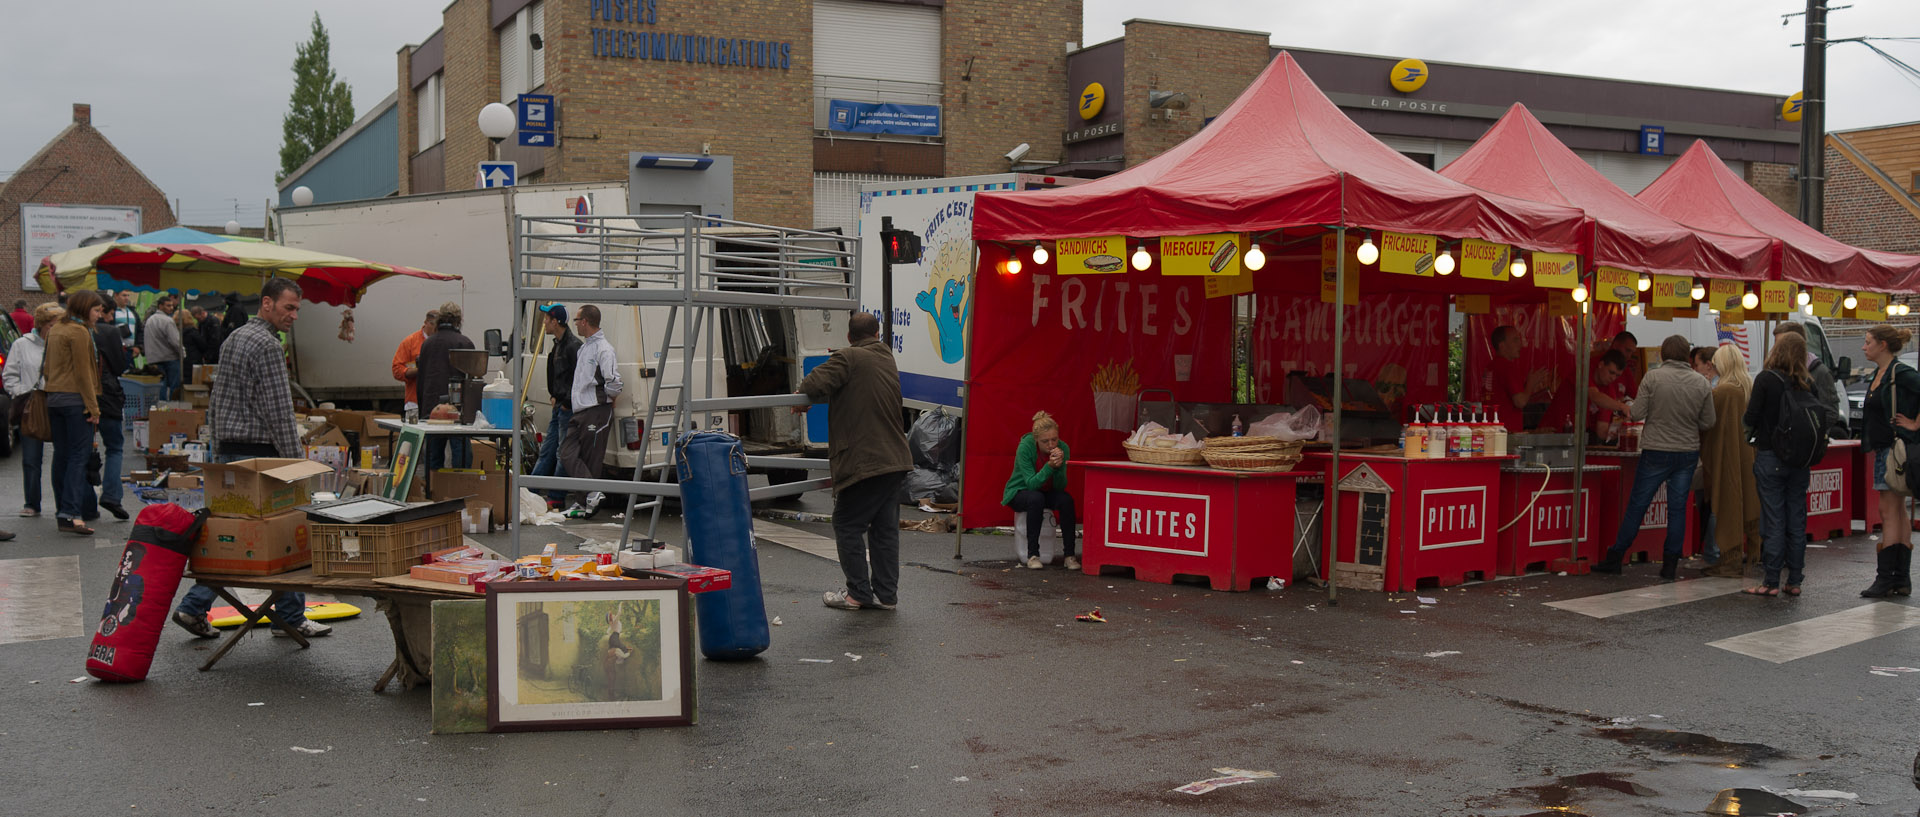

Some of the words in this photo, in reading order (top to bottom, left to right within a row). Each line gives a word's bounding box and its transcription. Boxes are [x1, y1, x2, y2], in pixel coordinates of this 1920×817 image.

[590, 0, 656, 24] POSTES
[591, 27, 791, 69] TELECOMMUNICATIONS
[1371, 98, 1389, 107] LA
[1399, 101, 1447, 112] POSTE
[1066, 131, 1079, 141] LA
[1083, 123, 1117, 137] POSTE
[925, 208, 945, 243] FRITE
[946, 200, 967, 218] C'EST
[1059, 239, 1108, 255] SANDWICHS
[1162, 240, 1215, 256] MERGUEZ
[1383, 234, 1428, 254] FRICADELLE
[1464, 244, 1496, 260] SAUCISSE
[1535, 261, 1561, 276] JAMBON
[1599, 269, 1629, 285] SANDWICHS
[1655, 282, 1674, 297] THON
[1711, 280, 1737, 294] AMERICAIN
[1032, 273, 1192, 335] FRITES
[1764, 290, 1785, 304] FRITES
[1814, 290, 1834, 304] MERGUEZ
[1810, 491, 1832, 512] GEANT
[1118, 507, 1196, 539] FRITES
[1428, 504, 1475, 532] PITTA
[1538, 505, 1572, 530] PITT
